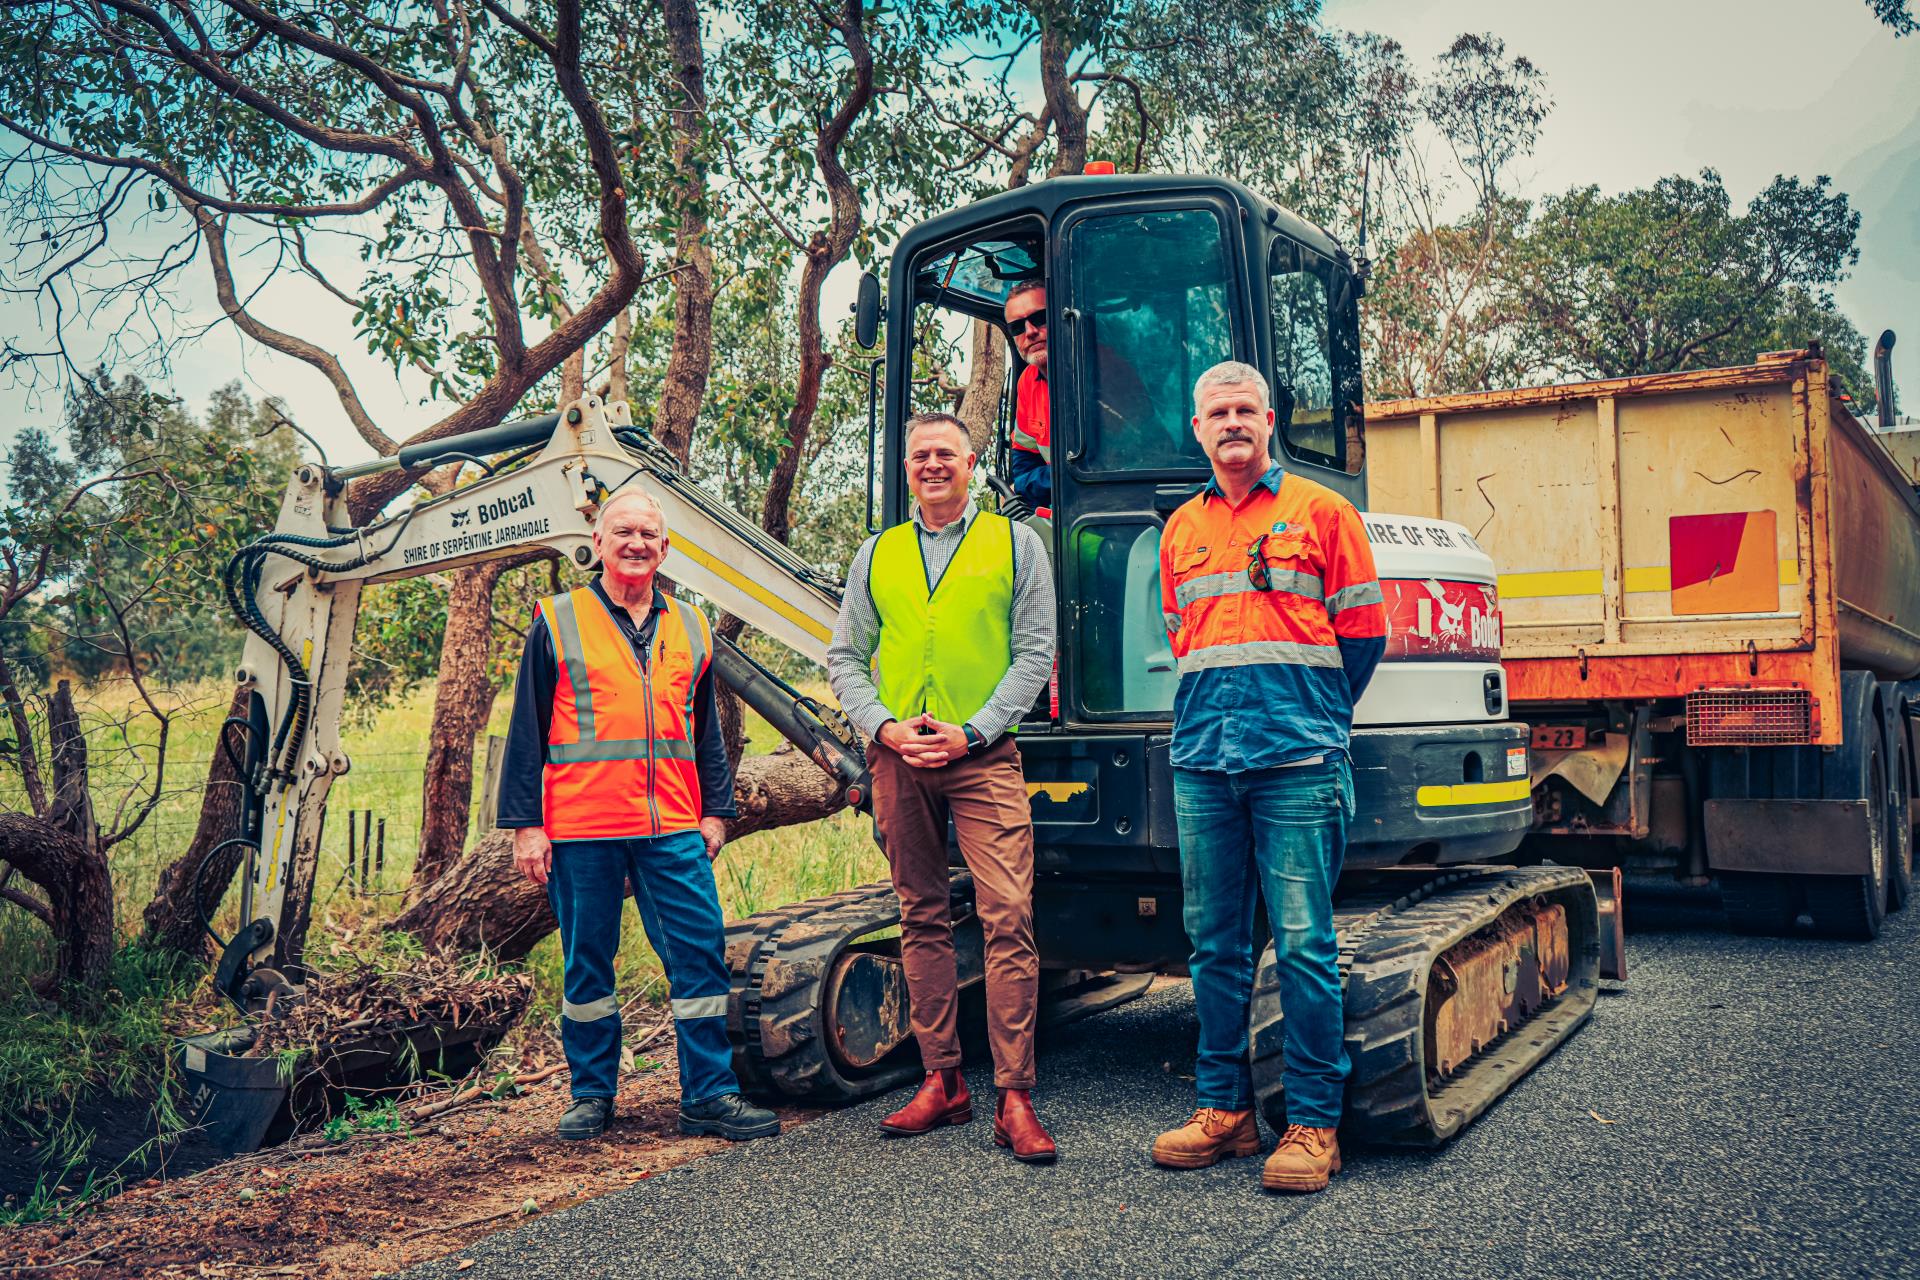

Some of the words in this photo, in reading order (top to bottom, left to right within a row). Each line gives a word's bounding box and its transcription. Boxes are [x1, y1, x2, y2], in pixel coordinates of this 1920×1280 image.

[477, 486, 535, 525] Bobcat
[404, 546, 428, 564] SHIRE
[430, 542, 440, 558] OF
[442, 531, 493, 556] SERPENTINE
[495, 518, 550, 544] JARRAHDALE
[1402, 525, 1425, 546] OF
[1554, 729, 1574, 747] 23
